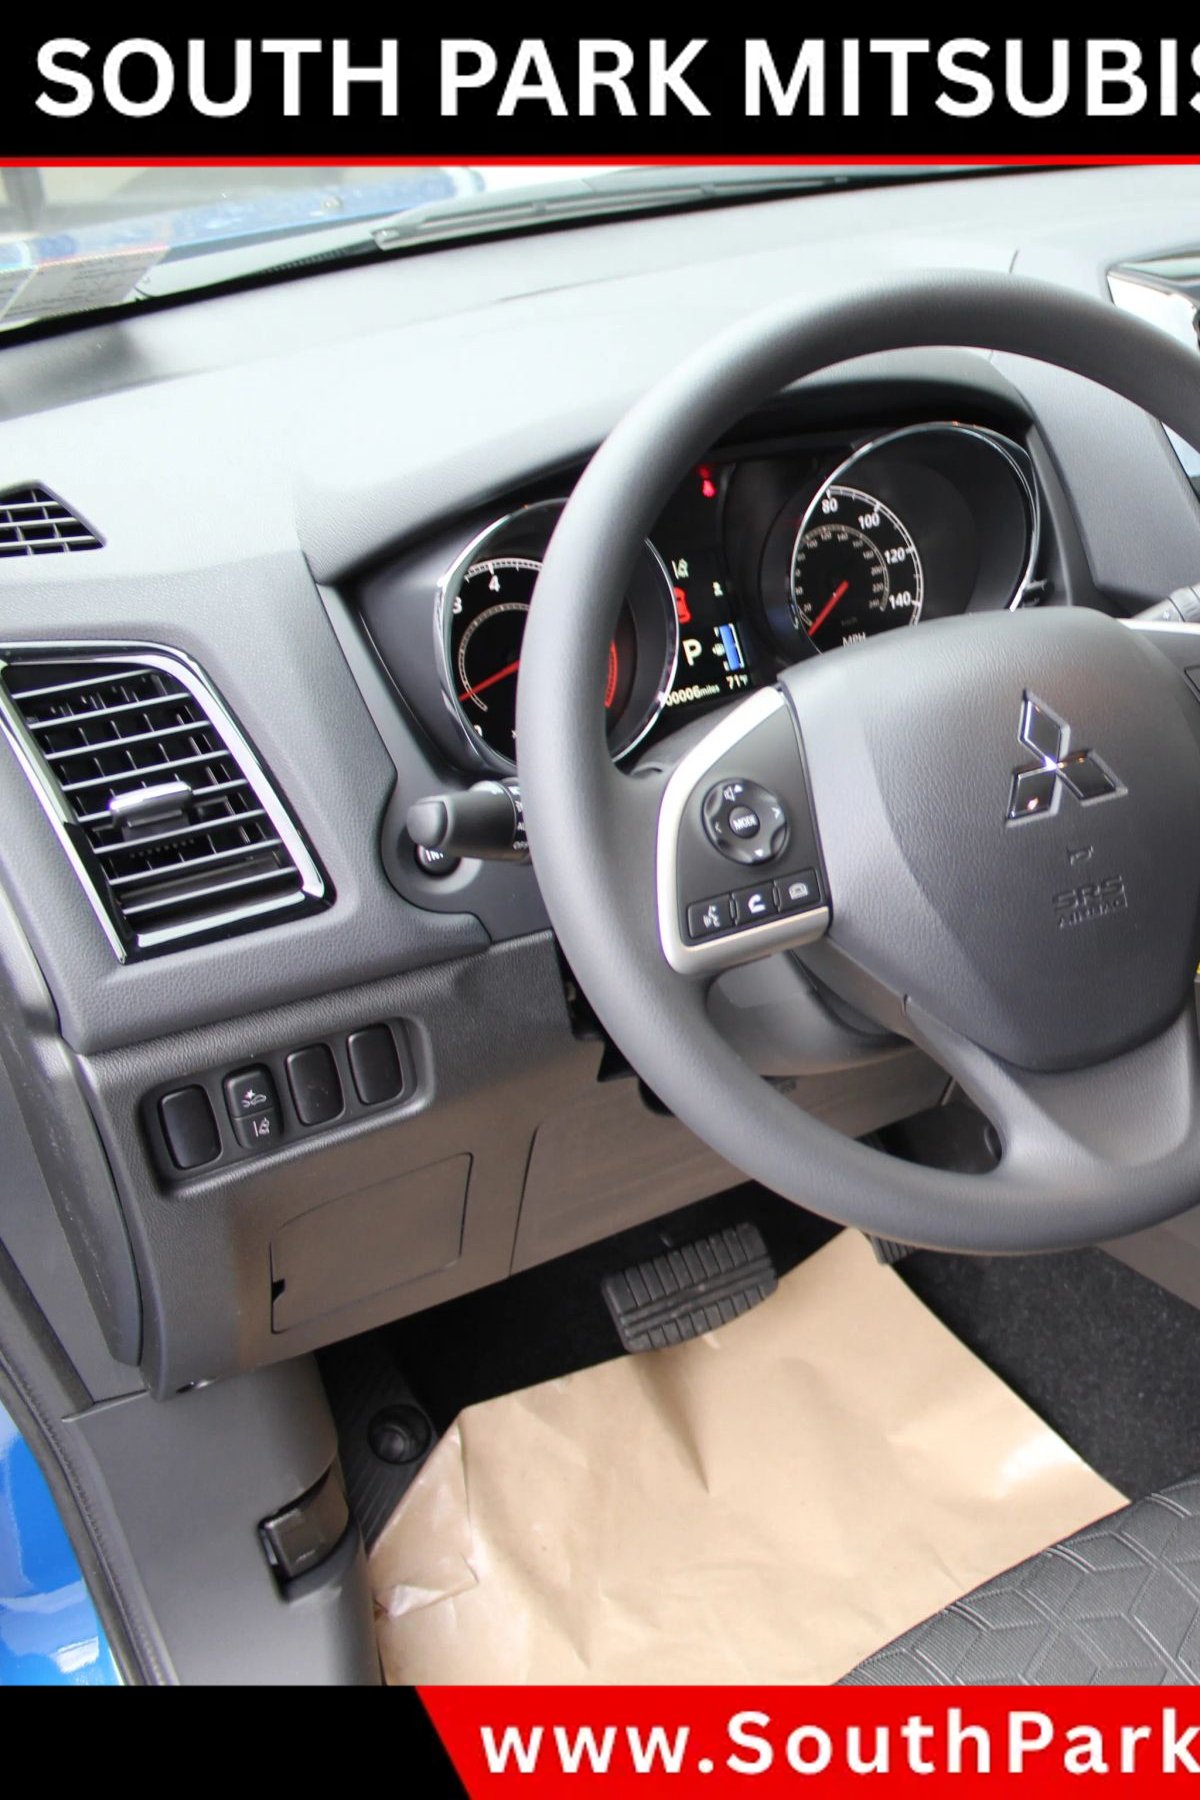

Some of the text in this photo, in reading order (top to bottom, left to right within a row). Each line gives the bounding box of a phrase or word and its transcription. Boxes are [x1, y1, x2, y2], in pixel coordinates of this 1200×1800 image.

[821, 497, 838, 514] 80
[858, 513, 880, 530] 100
[884, 547, 906, 565] 120
[488, 576, 500, 592] 4
[889, 591, 911, 610] 140
[682, 638, 703, 666] P
[733, 813, 758, 831] MODE
